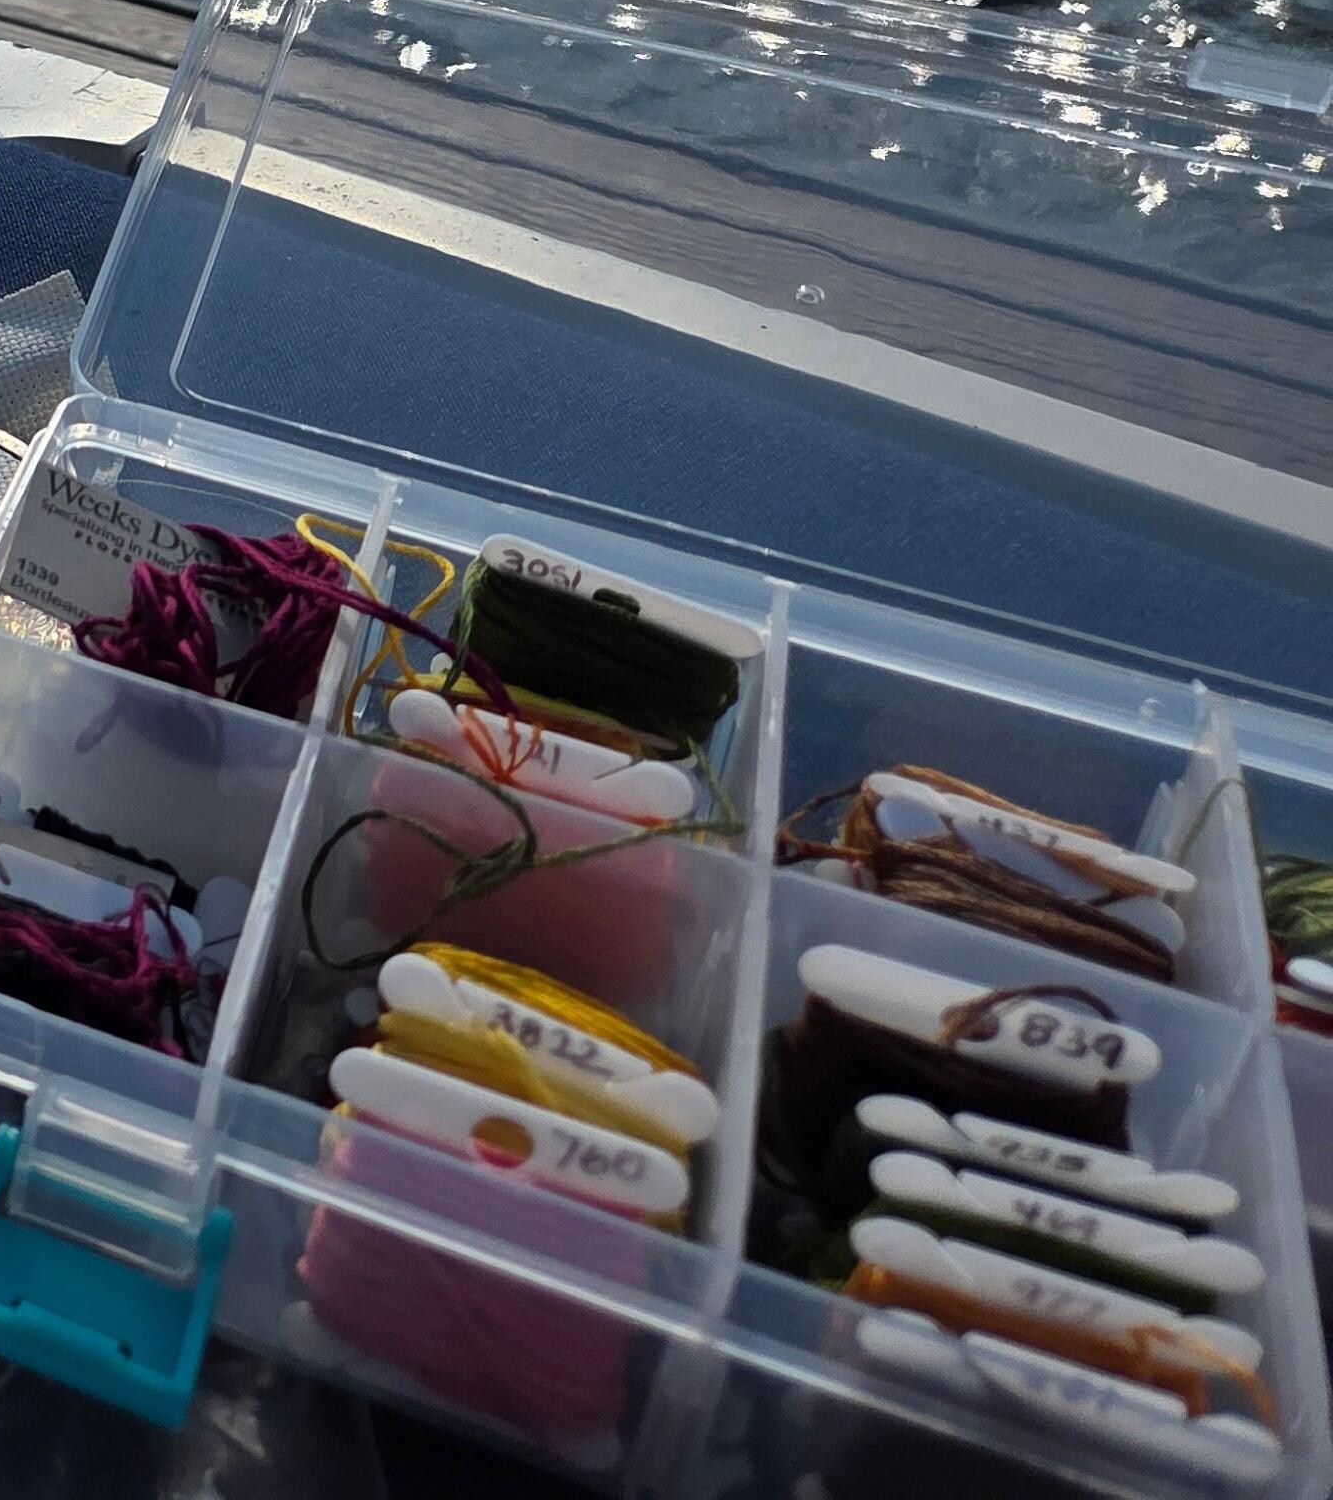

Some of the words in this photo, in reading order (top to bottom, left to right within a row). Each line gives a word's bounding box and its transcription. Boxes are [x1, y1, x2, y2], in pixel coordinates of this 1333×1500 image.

[48, 468, 141, 535] Weeks
[74, 530, 132, 563] FLOSS
[502, 547, 582, 590] 3051
[1019, 1013, 1126, 1071] 839
[552, 1128, 647, 1182] 760
